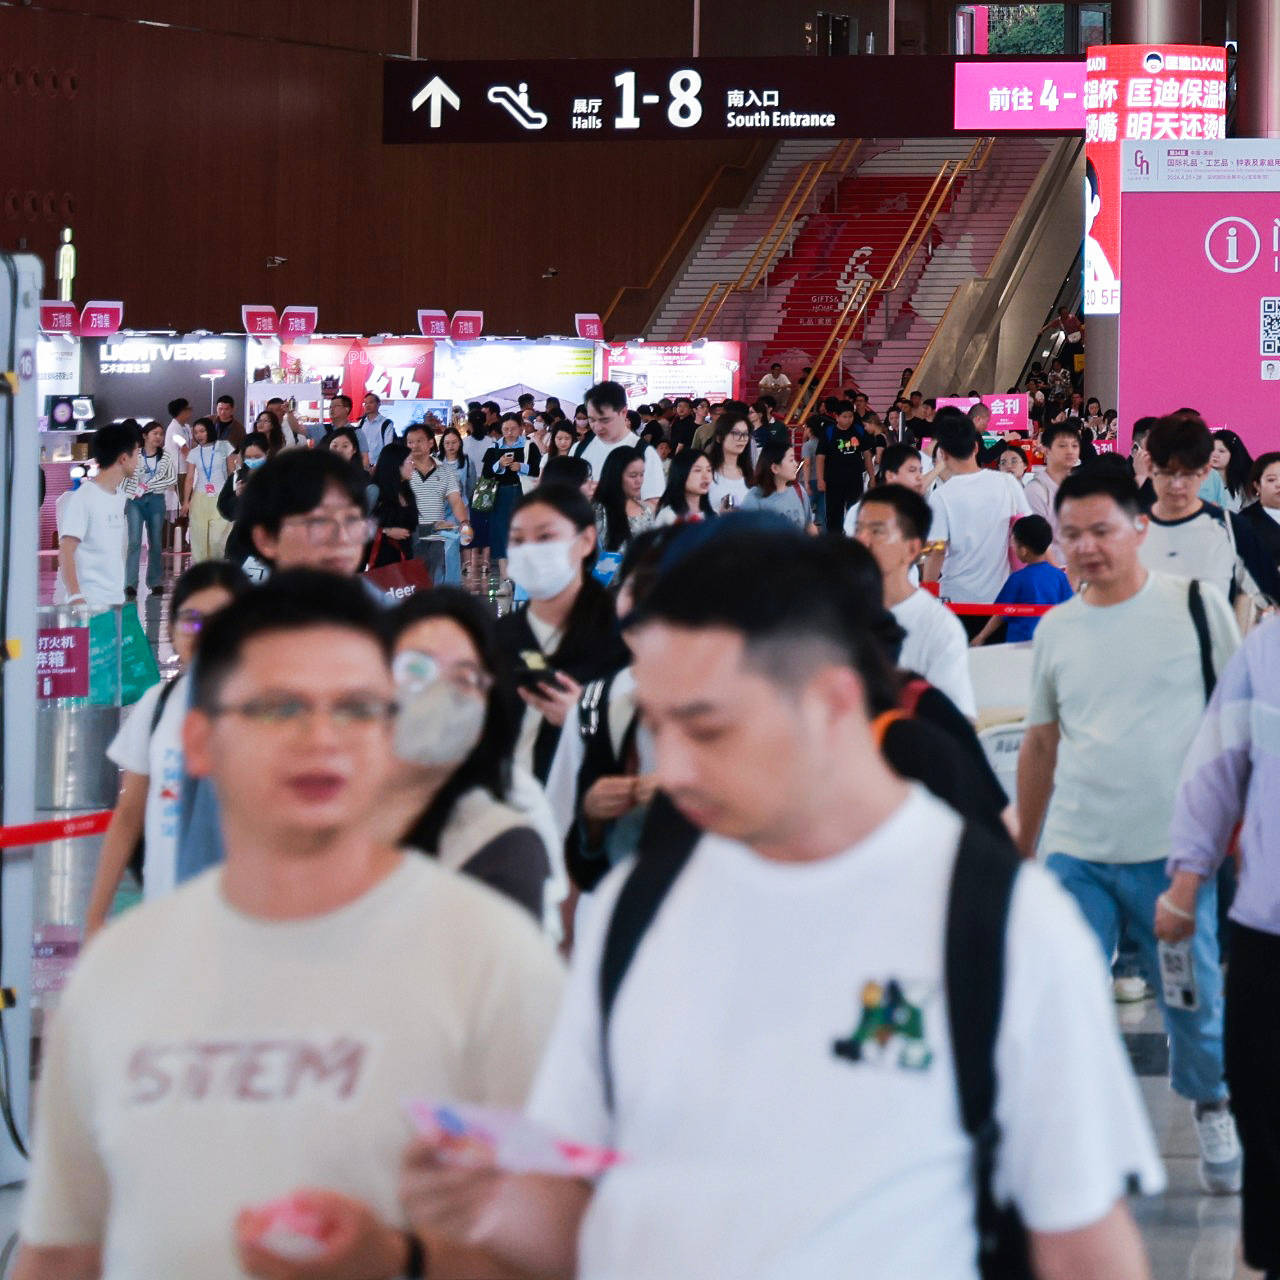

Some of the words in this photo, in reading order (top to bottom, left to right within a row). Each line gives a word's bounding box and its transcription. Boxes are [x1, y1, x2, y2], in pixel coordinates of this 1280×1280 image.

[572, 99, 602, 114] 展厅
[613, 69, 703, 130] 1-8
[727, 89, 779, 108] 南入口
[572, 115, 602, 130] Halls
[727, 111, 770, 128] South
[772, 111, 836, 128] Entrance
[1126, 111, 1226, 140] 明天还烫
[991, 399, 1020, 415] 会刊
[127, 1038, 371, 1105] STEM
